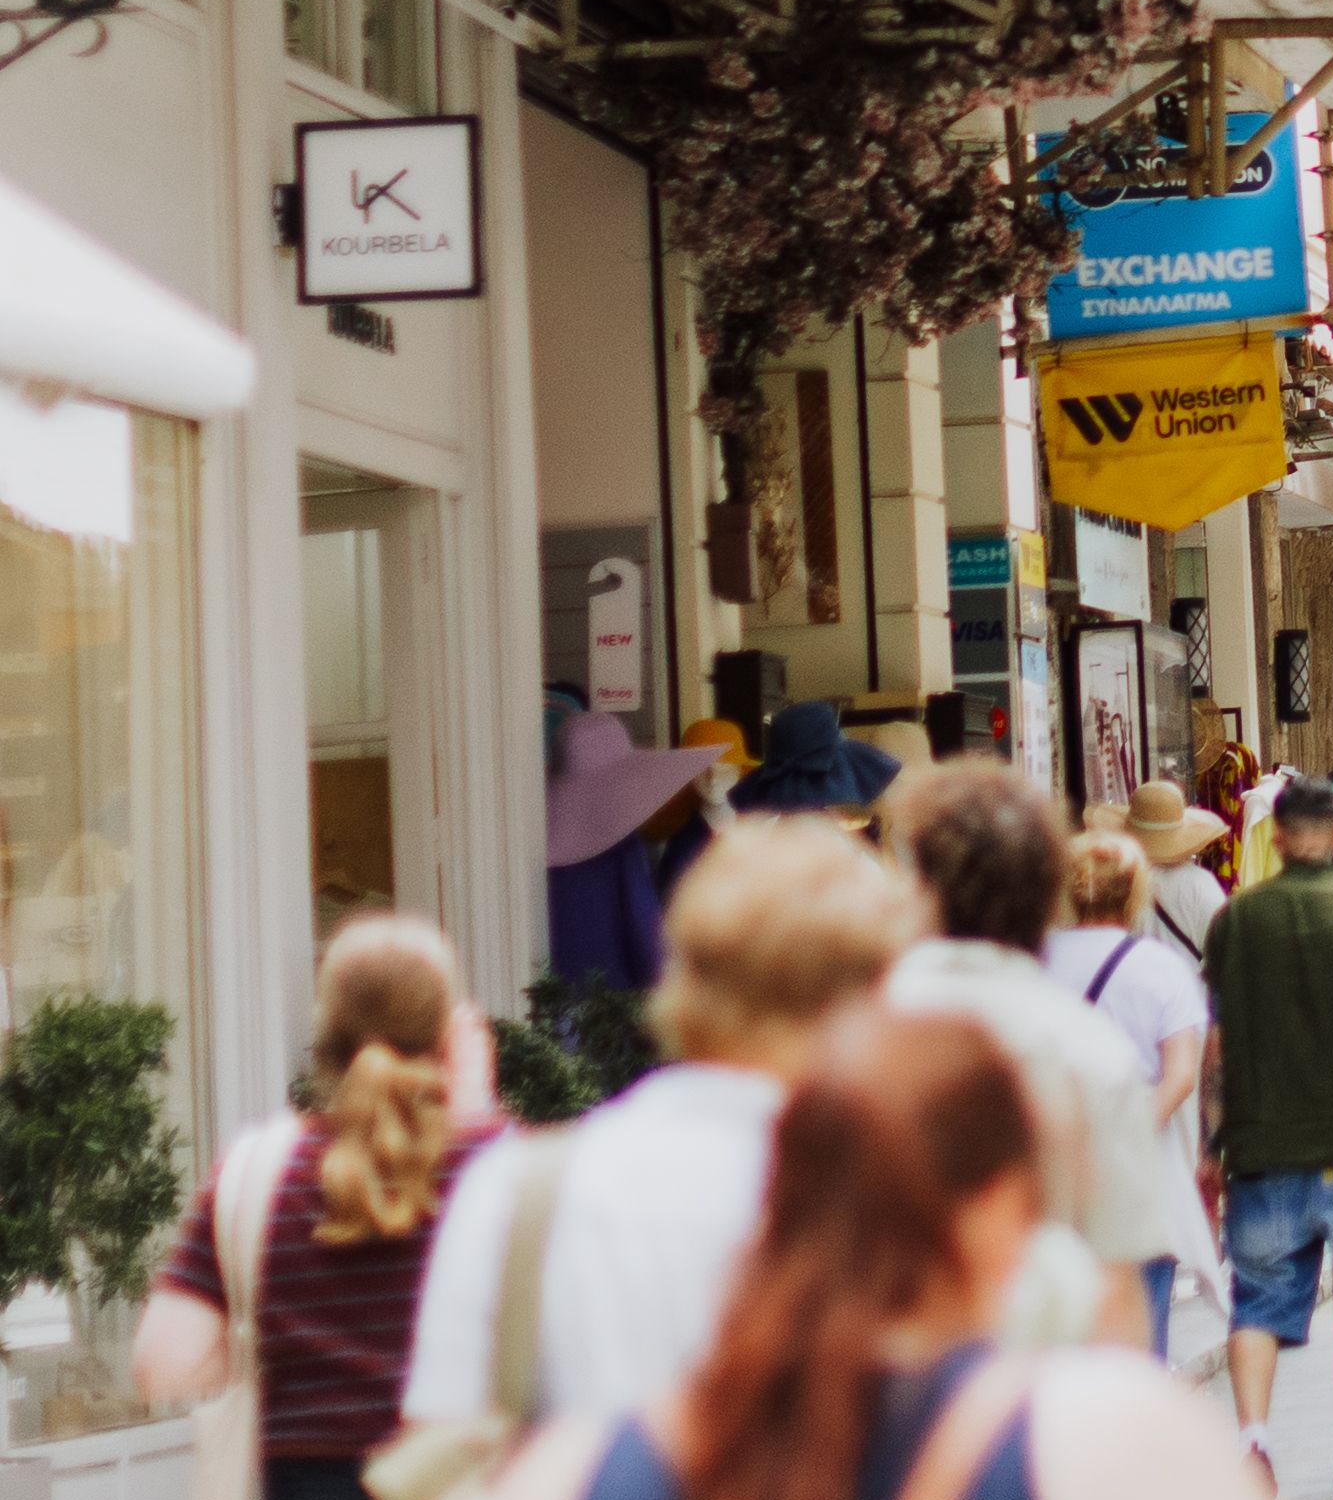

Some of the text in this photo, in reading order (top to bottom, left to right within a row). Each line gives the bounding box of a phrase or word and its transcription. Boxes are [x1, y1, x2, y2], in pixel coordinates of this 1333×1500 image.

[322, 233, 451, 257] KOURBELA
[1077, 247, 1274, 287] EXCHANGE
[1082, 291, 1231, 318] ΣΥΝΑΛΛΑΓΜΑ
[1150, 380, 1265, 410] Western
[1156, 409, 1236, 440] Union
[949, 547, 1007, 562] ASH
[597, 634, 633, 647] NEW
[954, 620, 1003, 642] VISA
